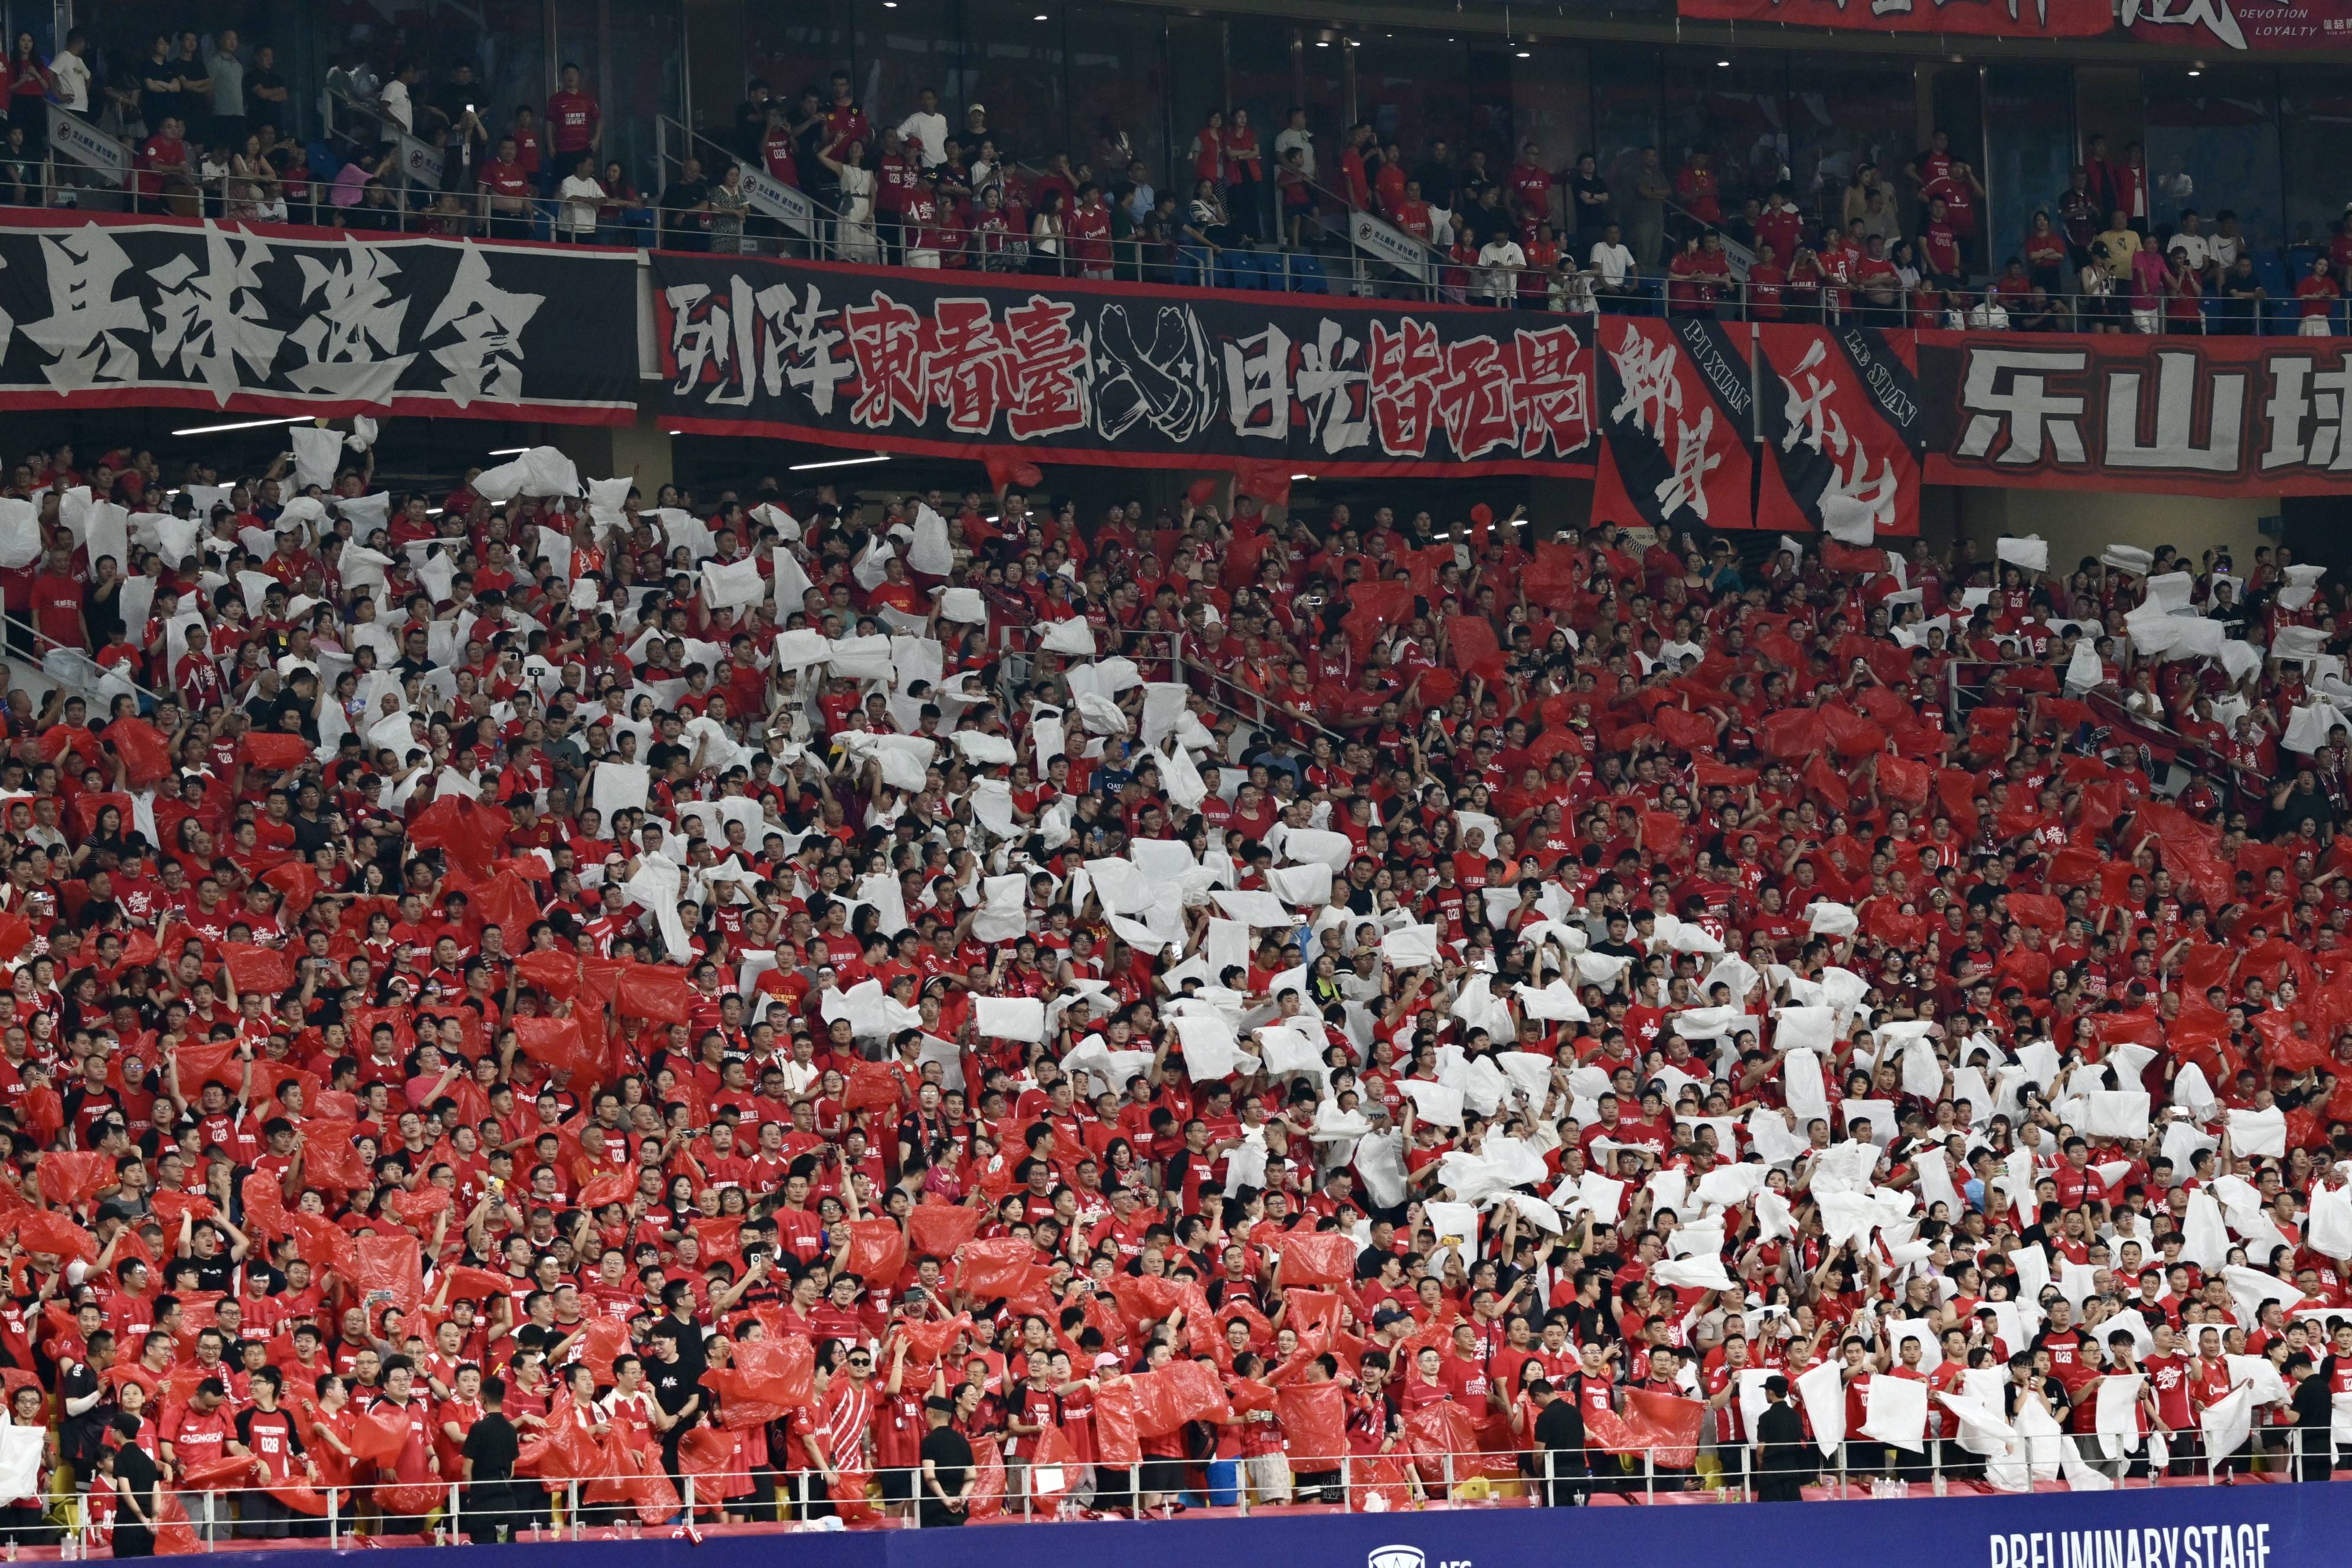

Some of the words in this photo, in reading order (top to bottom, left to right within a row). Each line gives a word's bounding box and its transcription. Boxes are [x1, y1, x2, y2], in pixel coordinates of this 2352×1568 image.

[2239, 9, 2308, 18] DEVOTION
[2255, 27, 2317, 36] LOYALTY
[774, 149, 786, 159] 028
[889, 174, 900, 183] 028
[0, 218, 546, 409] 县球迷会
[1683, 319, 1713, 359] PI
[1703, 351, 1751, 415] XIAN
[1844, 329, 1871, 367] LE
[1867, 363, 1917, 427] SHAN
[2011, 597, 2022, 607] 028
[128, 895, 149, 906] Better
[1448, 909, 1460, 920] 028
[254, 931, 274, 939] Better
[212, 1129, 227, 1141] 028
[612, 1149, 625, 1162] 028
[2056, 1351, 2071, 1363] 028
[2157, 1370, 2182, 1381] Better
[2160, 1379, 2177, 1389] City
[1593, 1397, 1606, 1409] 028
[254, 1426, 285, 1434] FORBETTERCITY
[262, 1438, 279, 1452] 028
[1990, 1527, 2178, 1568] PRELIMINARY
[2184, 1524, 2270, 1568] STAGE
